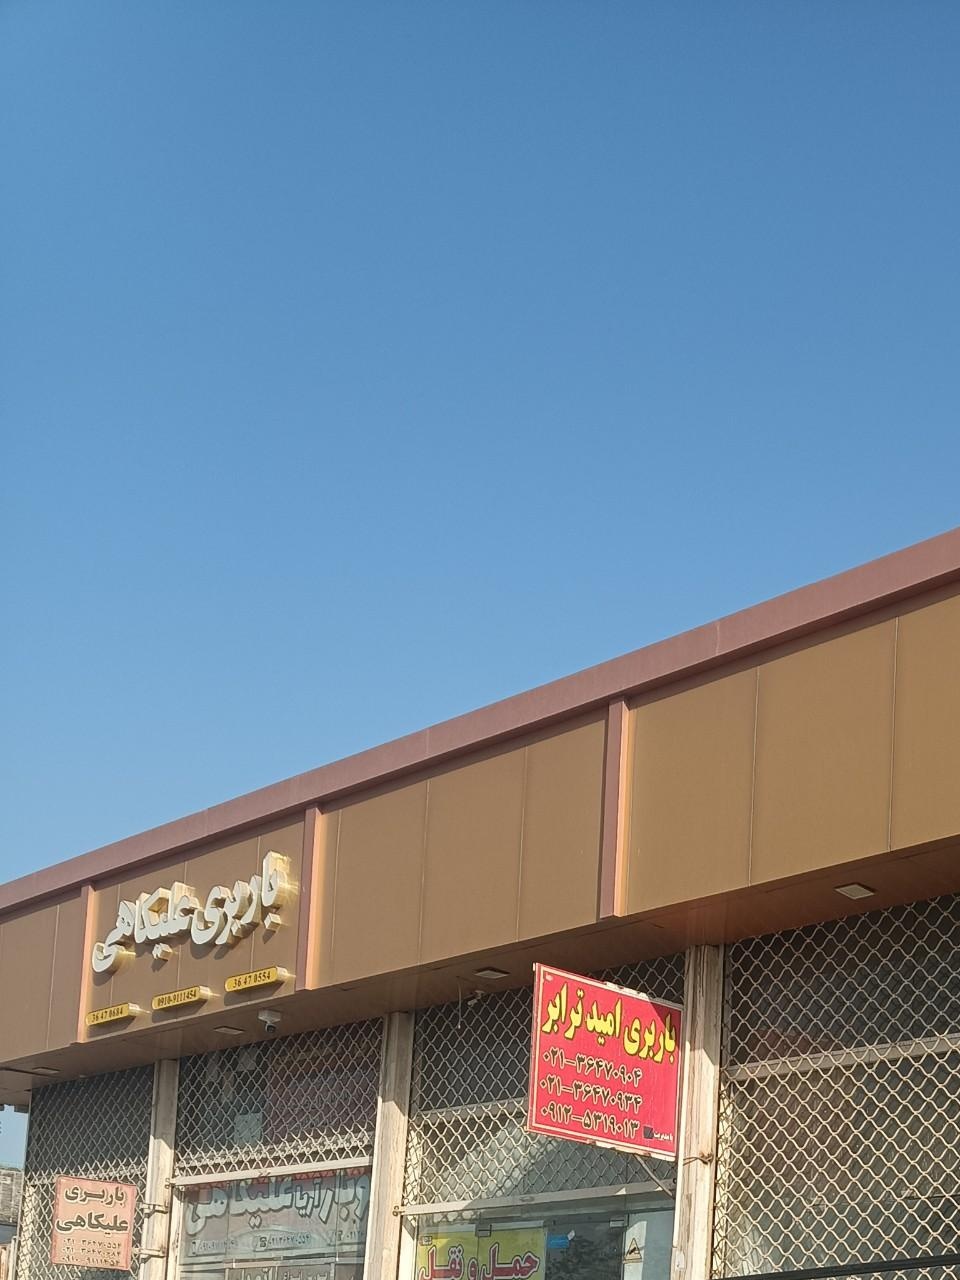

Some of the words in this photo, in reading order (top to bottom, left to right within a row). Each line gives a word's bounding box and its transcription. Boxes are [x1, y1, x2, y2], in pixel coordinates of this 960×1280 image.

[190, 851, 284, 945] باربری
[92, 882, 197, 973] علیکاهی
[541, 982, 585, 1040] ترابر
[585, 998, 622, 1046] امید
[623, 1013, 677, 1064] باربری
[64, 1186, 125, 1207] باربری
[56, 1211, 129, 1236] علیکاهی
